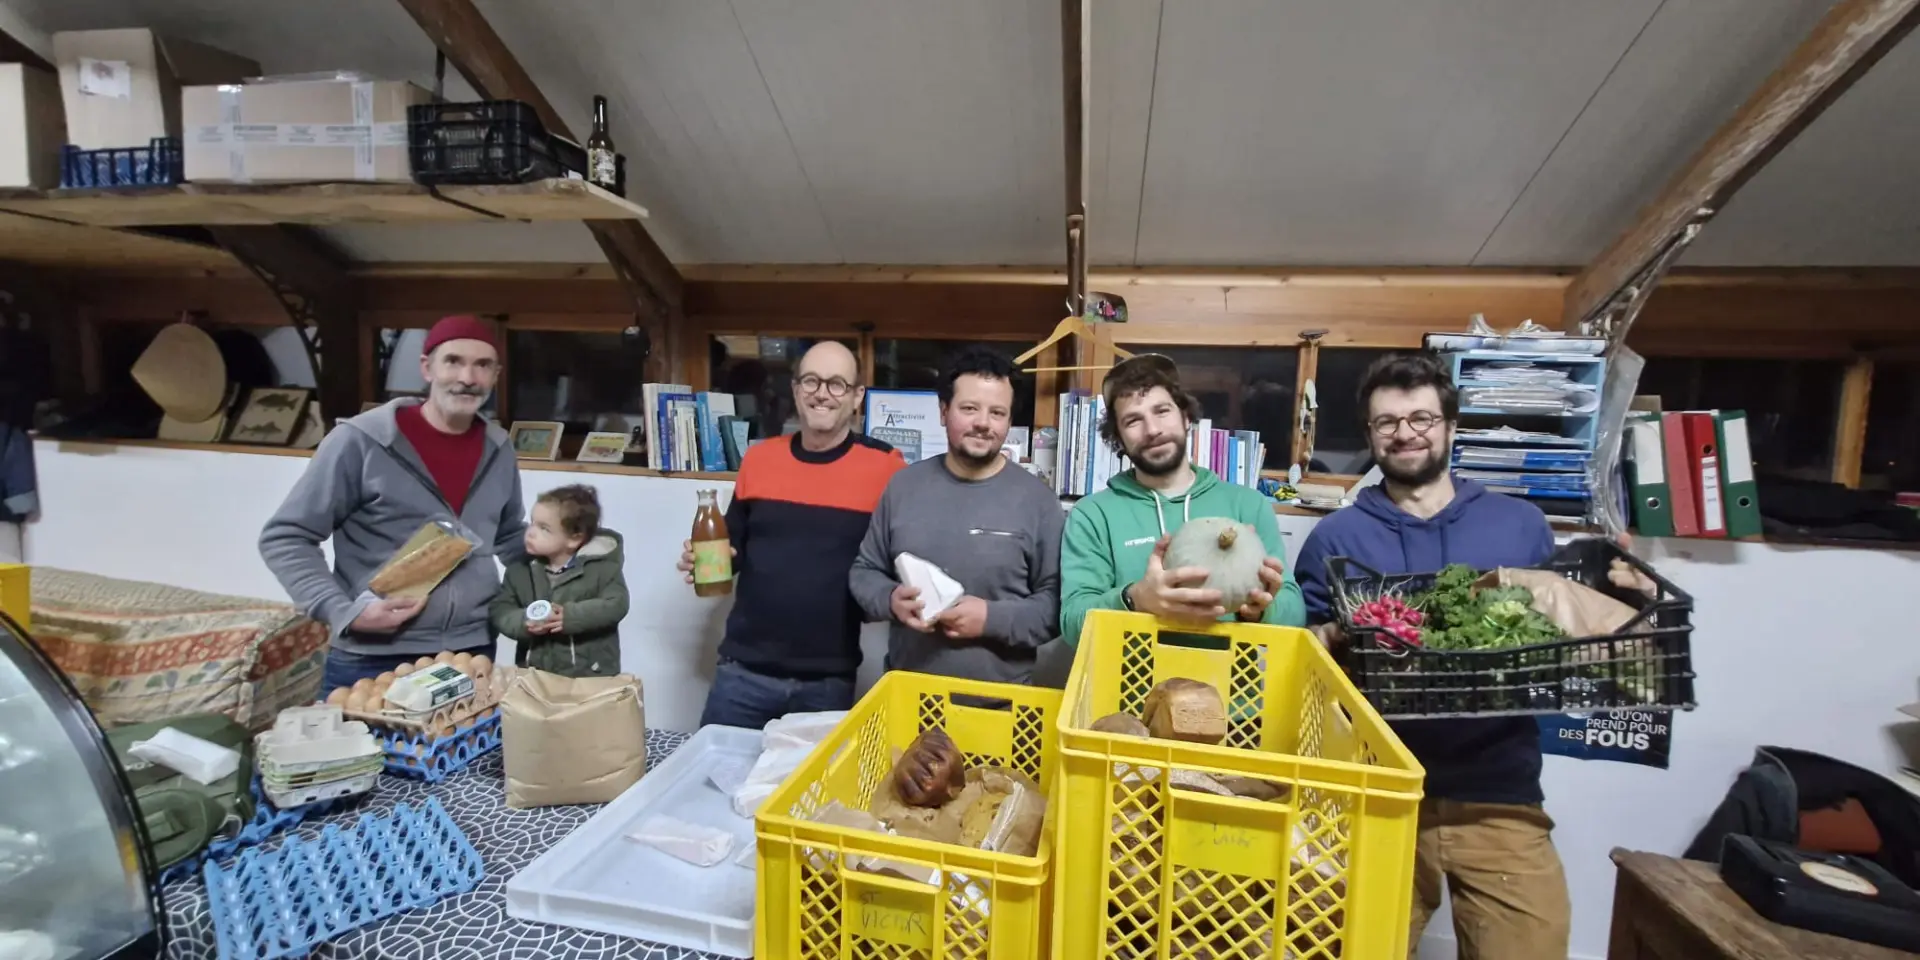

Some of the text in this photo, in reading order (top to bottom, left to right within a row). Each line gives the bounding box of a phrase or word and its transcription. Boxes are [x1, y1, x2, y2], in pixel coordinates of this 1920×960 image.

[1609, 709, 1652, 723] QU'ON
[1586, 718, 1667, 735] PREND POUR
[1559, 728, 1650, 751] DES FOUS
